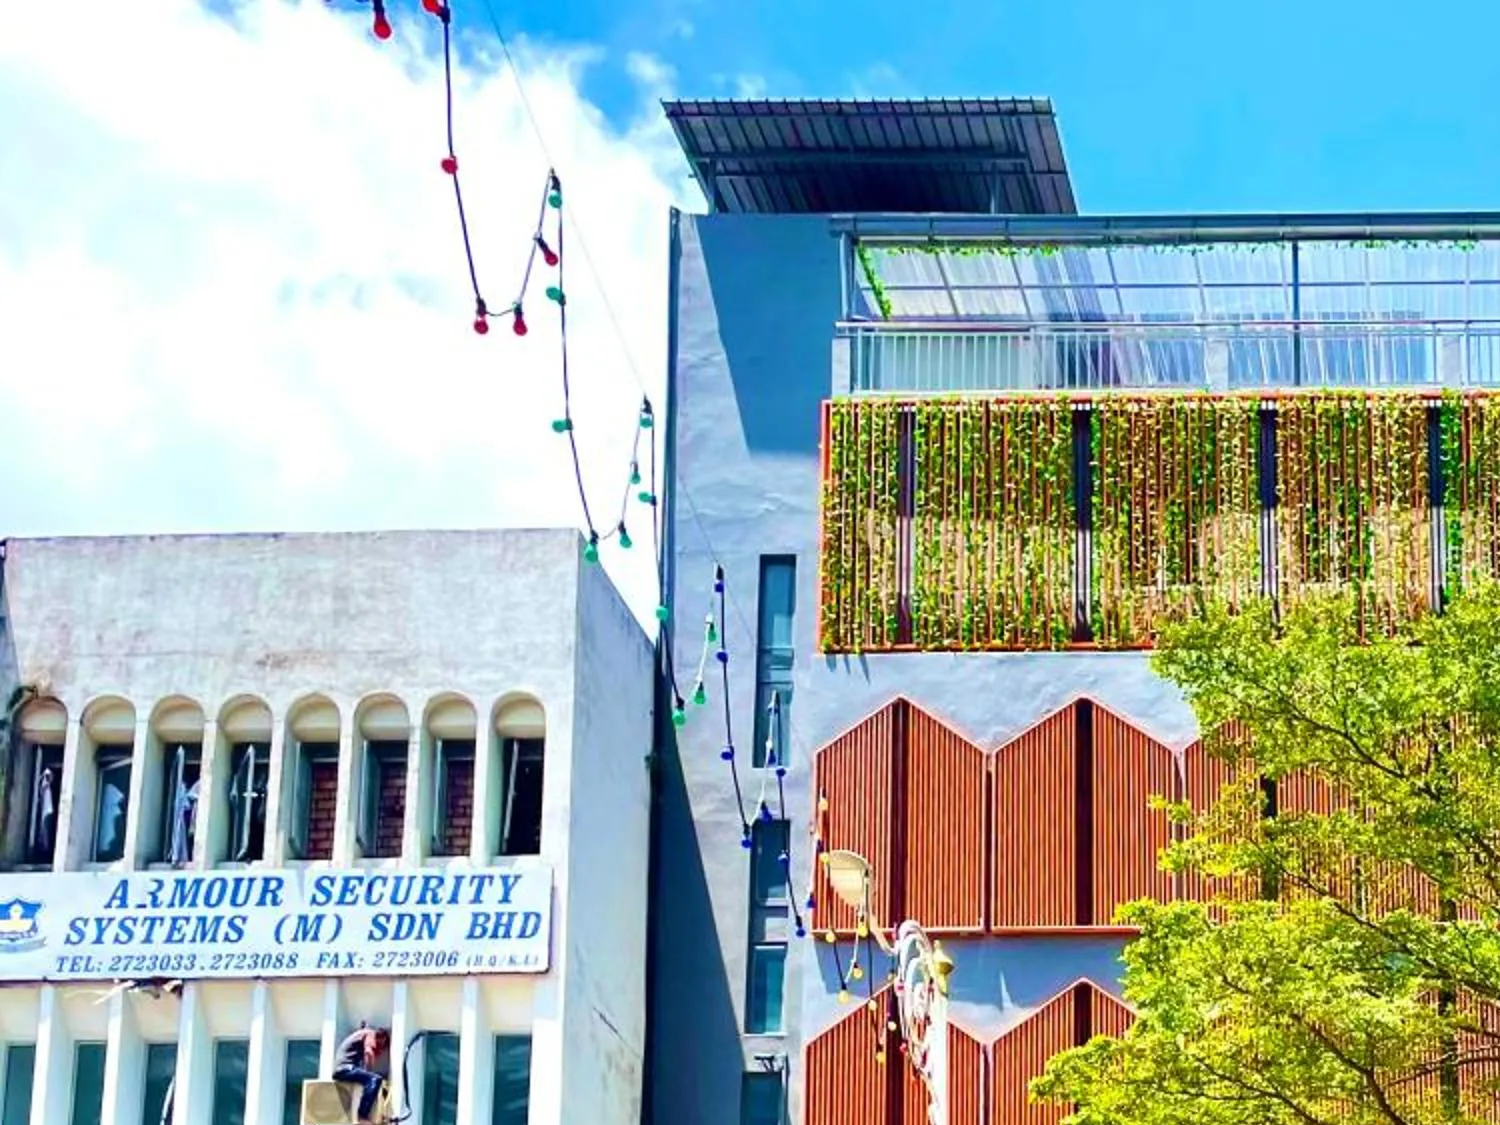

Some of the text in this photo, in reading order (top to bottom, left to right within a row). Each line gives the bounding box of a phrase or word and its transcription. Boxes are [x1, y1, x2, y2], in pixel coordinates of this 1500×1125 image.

[104, 874, 522, 909] ARMOUR SECURITY
[64, 911, 542, 946] SYSTEMS (M) SDN BHD
[56, 955, 102, 973] TEL:
[316, 952, 364, 969] FAX:
[372, 950, 459, 968] 2723006
